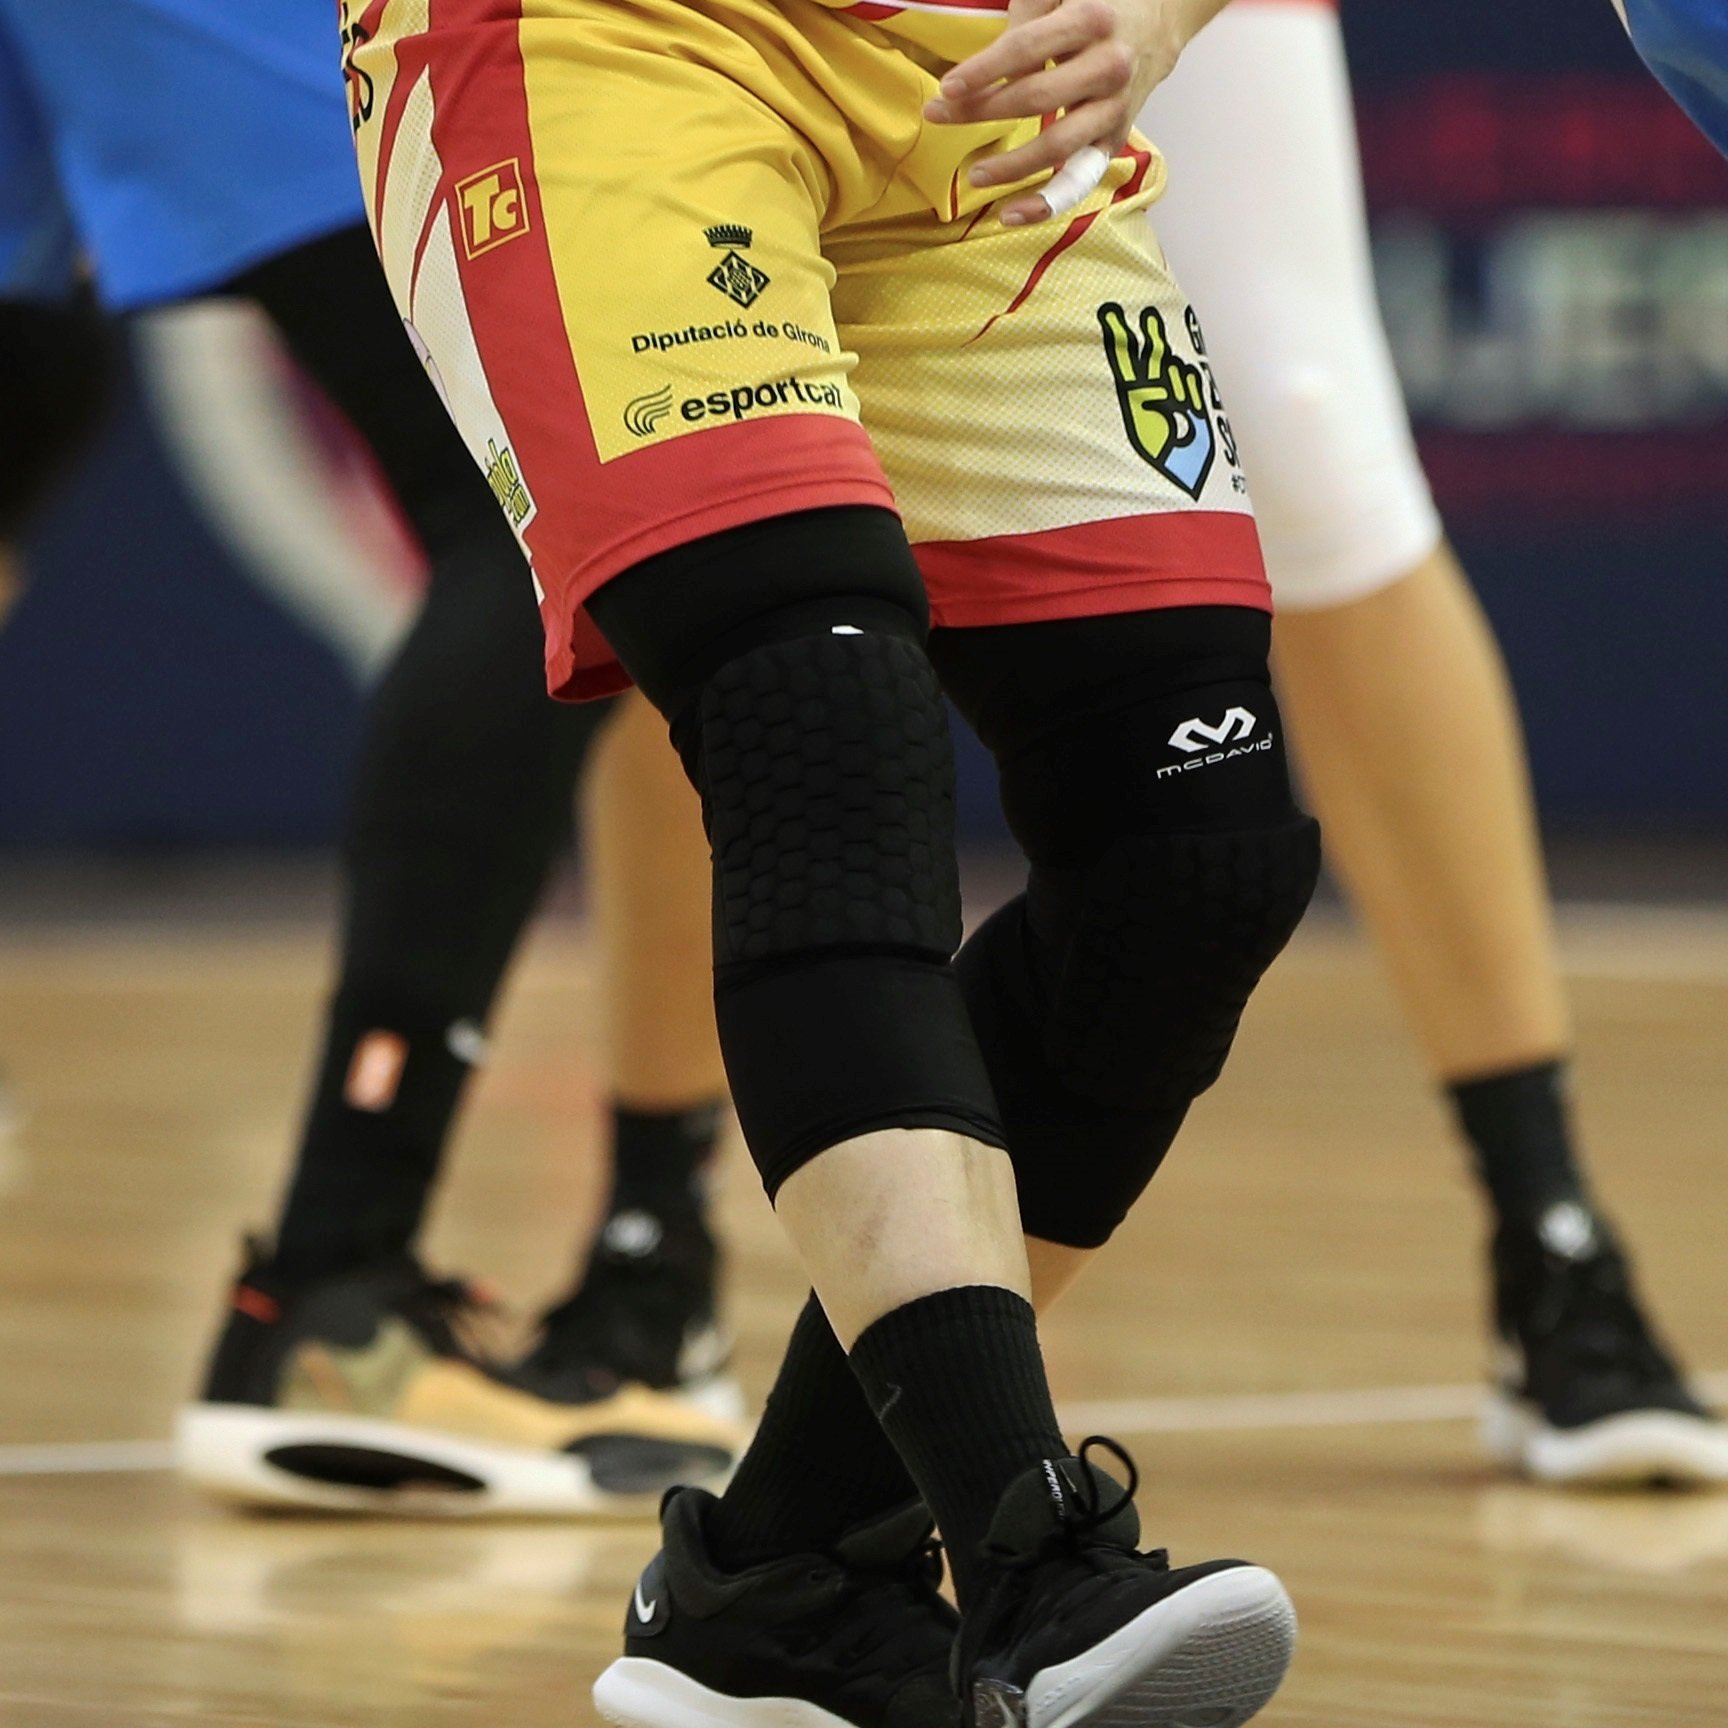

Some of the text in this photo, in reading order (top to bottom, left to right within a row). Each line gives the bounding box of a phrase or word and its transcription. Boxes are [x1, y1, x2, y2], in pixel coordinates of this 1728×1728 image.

[463, 173, 518, 247] Tc
[631, 318, 831, 355] Diputació de Girona
